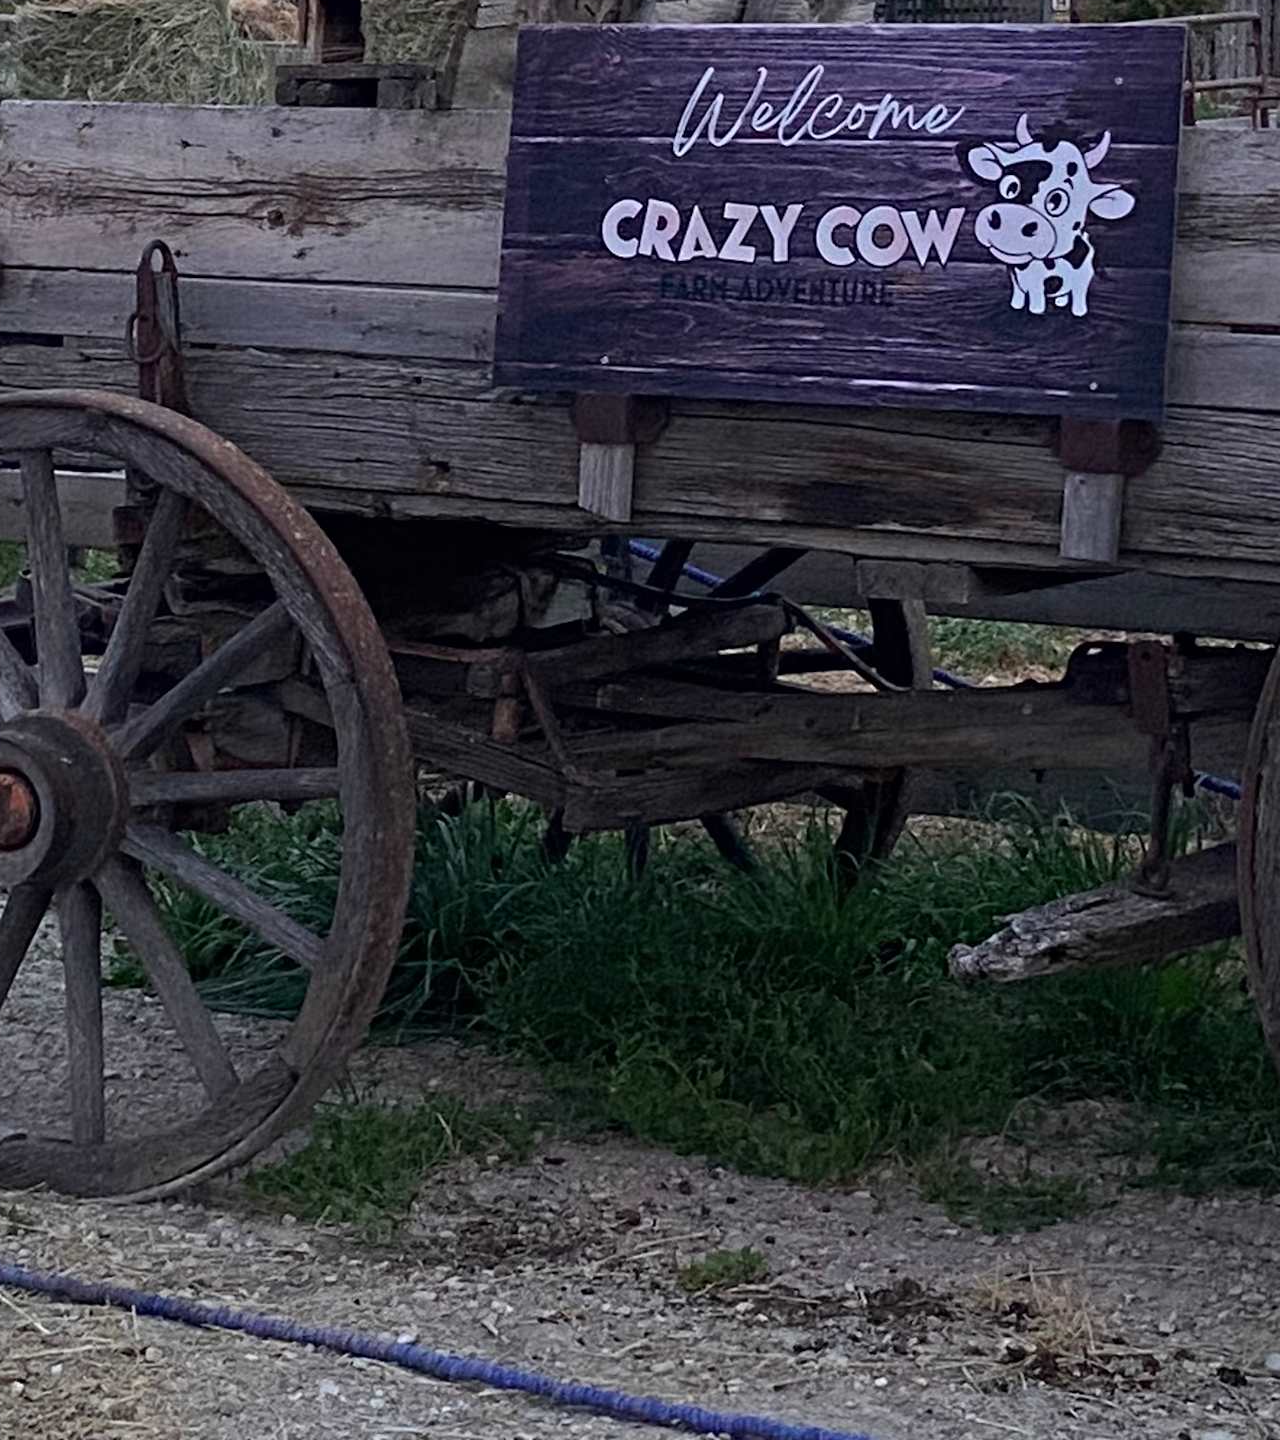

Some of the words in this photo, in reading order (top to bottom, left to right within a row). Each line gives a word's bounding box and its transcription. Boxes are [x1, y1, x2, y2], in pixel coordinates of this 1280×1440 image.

[673, 64, 966, 157] Welcome
[601, 198, 804, 263] CRAZY
[815, 204, 966, 268] COW
[658, 272, 727, 301] FARM
[739, 277, 898, 307] ADVENTURE
